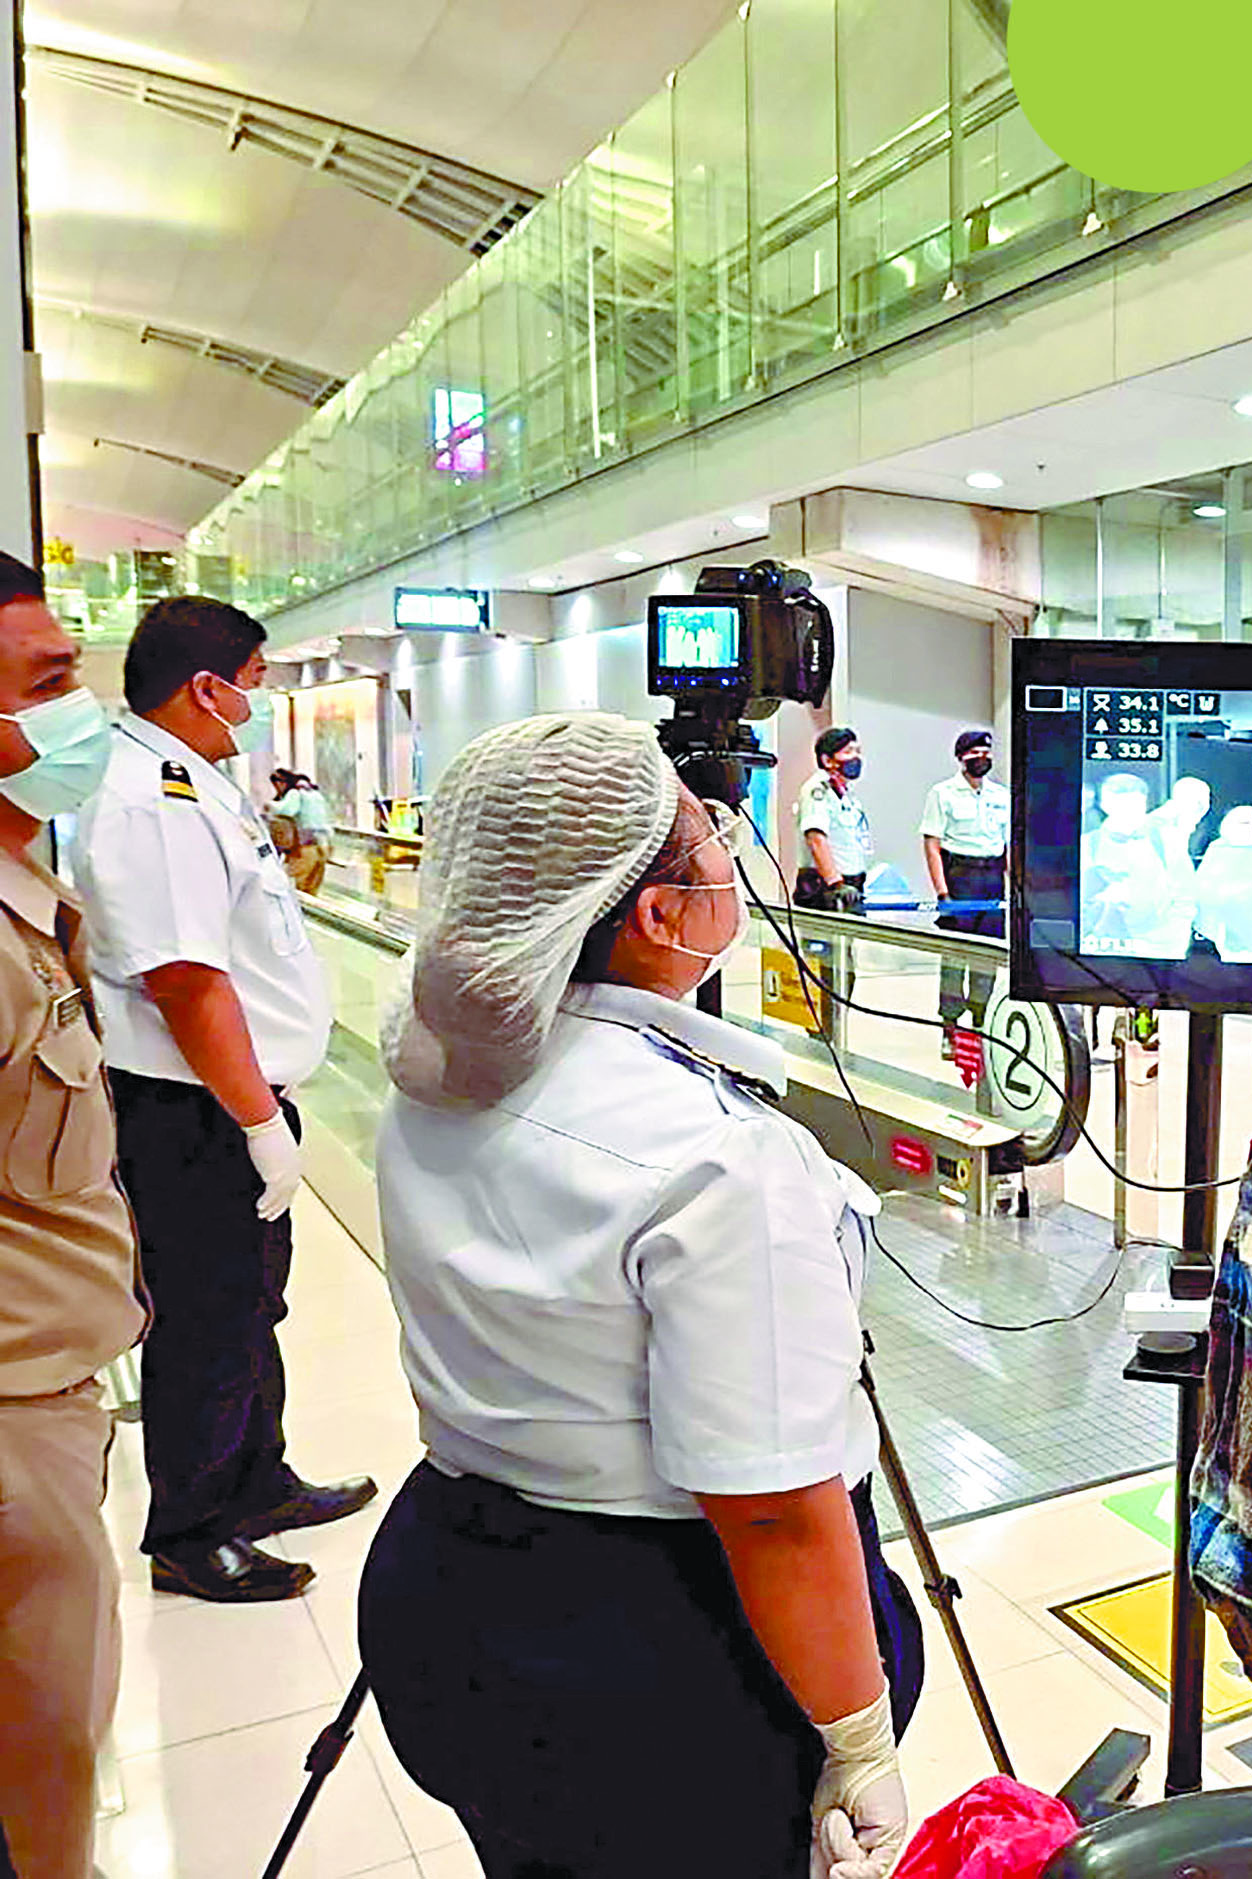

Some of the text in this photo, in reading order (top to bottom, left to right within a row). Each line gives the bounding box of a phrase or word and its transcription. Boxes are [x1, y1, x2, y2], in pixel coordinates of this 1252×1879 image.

[1119, 695, 1159, 712] 34.1
[1119, 718, 1159, 734] 35.1
[1118, 743, 1160, 758] 33.8
[1005, 1010, 1032, 1097] 2
